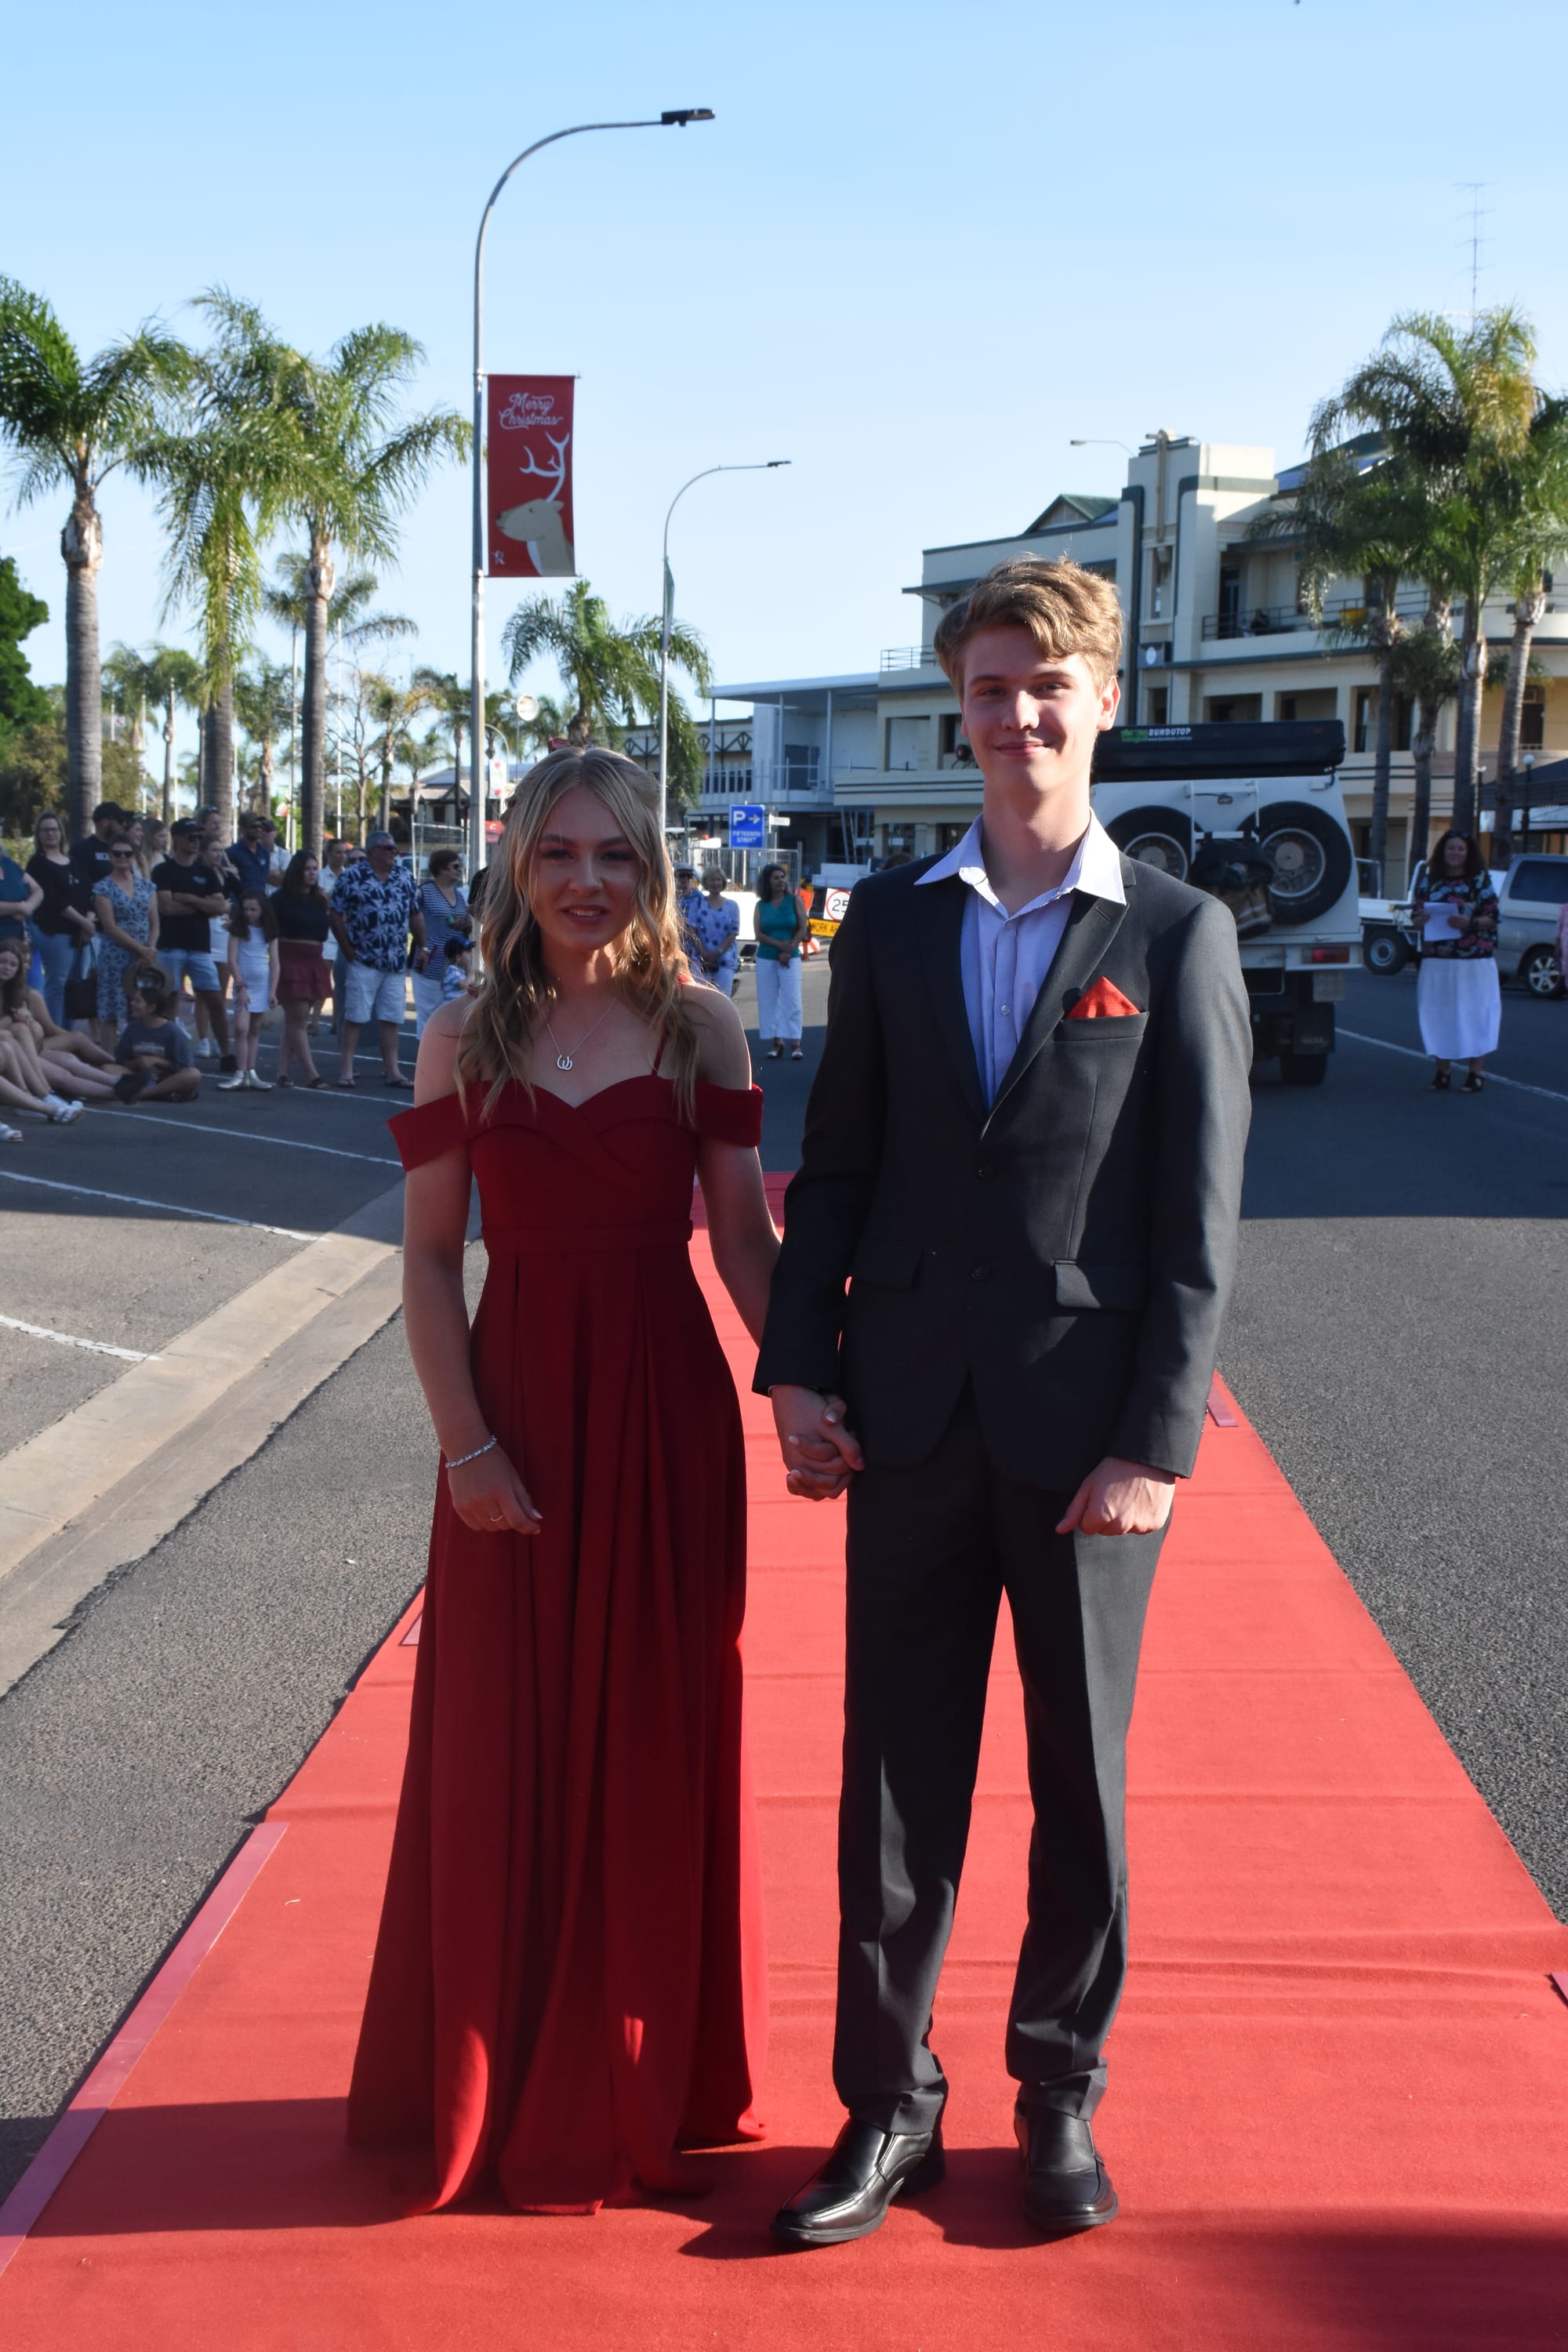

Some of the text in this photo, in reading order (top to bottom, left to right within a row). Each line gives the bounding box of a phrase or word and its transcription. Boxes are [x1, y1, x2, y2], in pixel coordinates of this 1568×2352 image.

[508, 392, 554, 416] Merry
[498, 408, 564, 430] Christmas
[1148, 727, 1191, 736] BUNDUTOP
[733, 810, 746, 826] P
